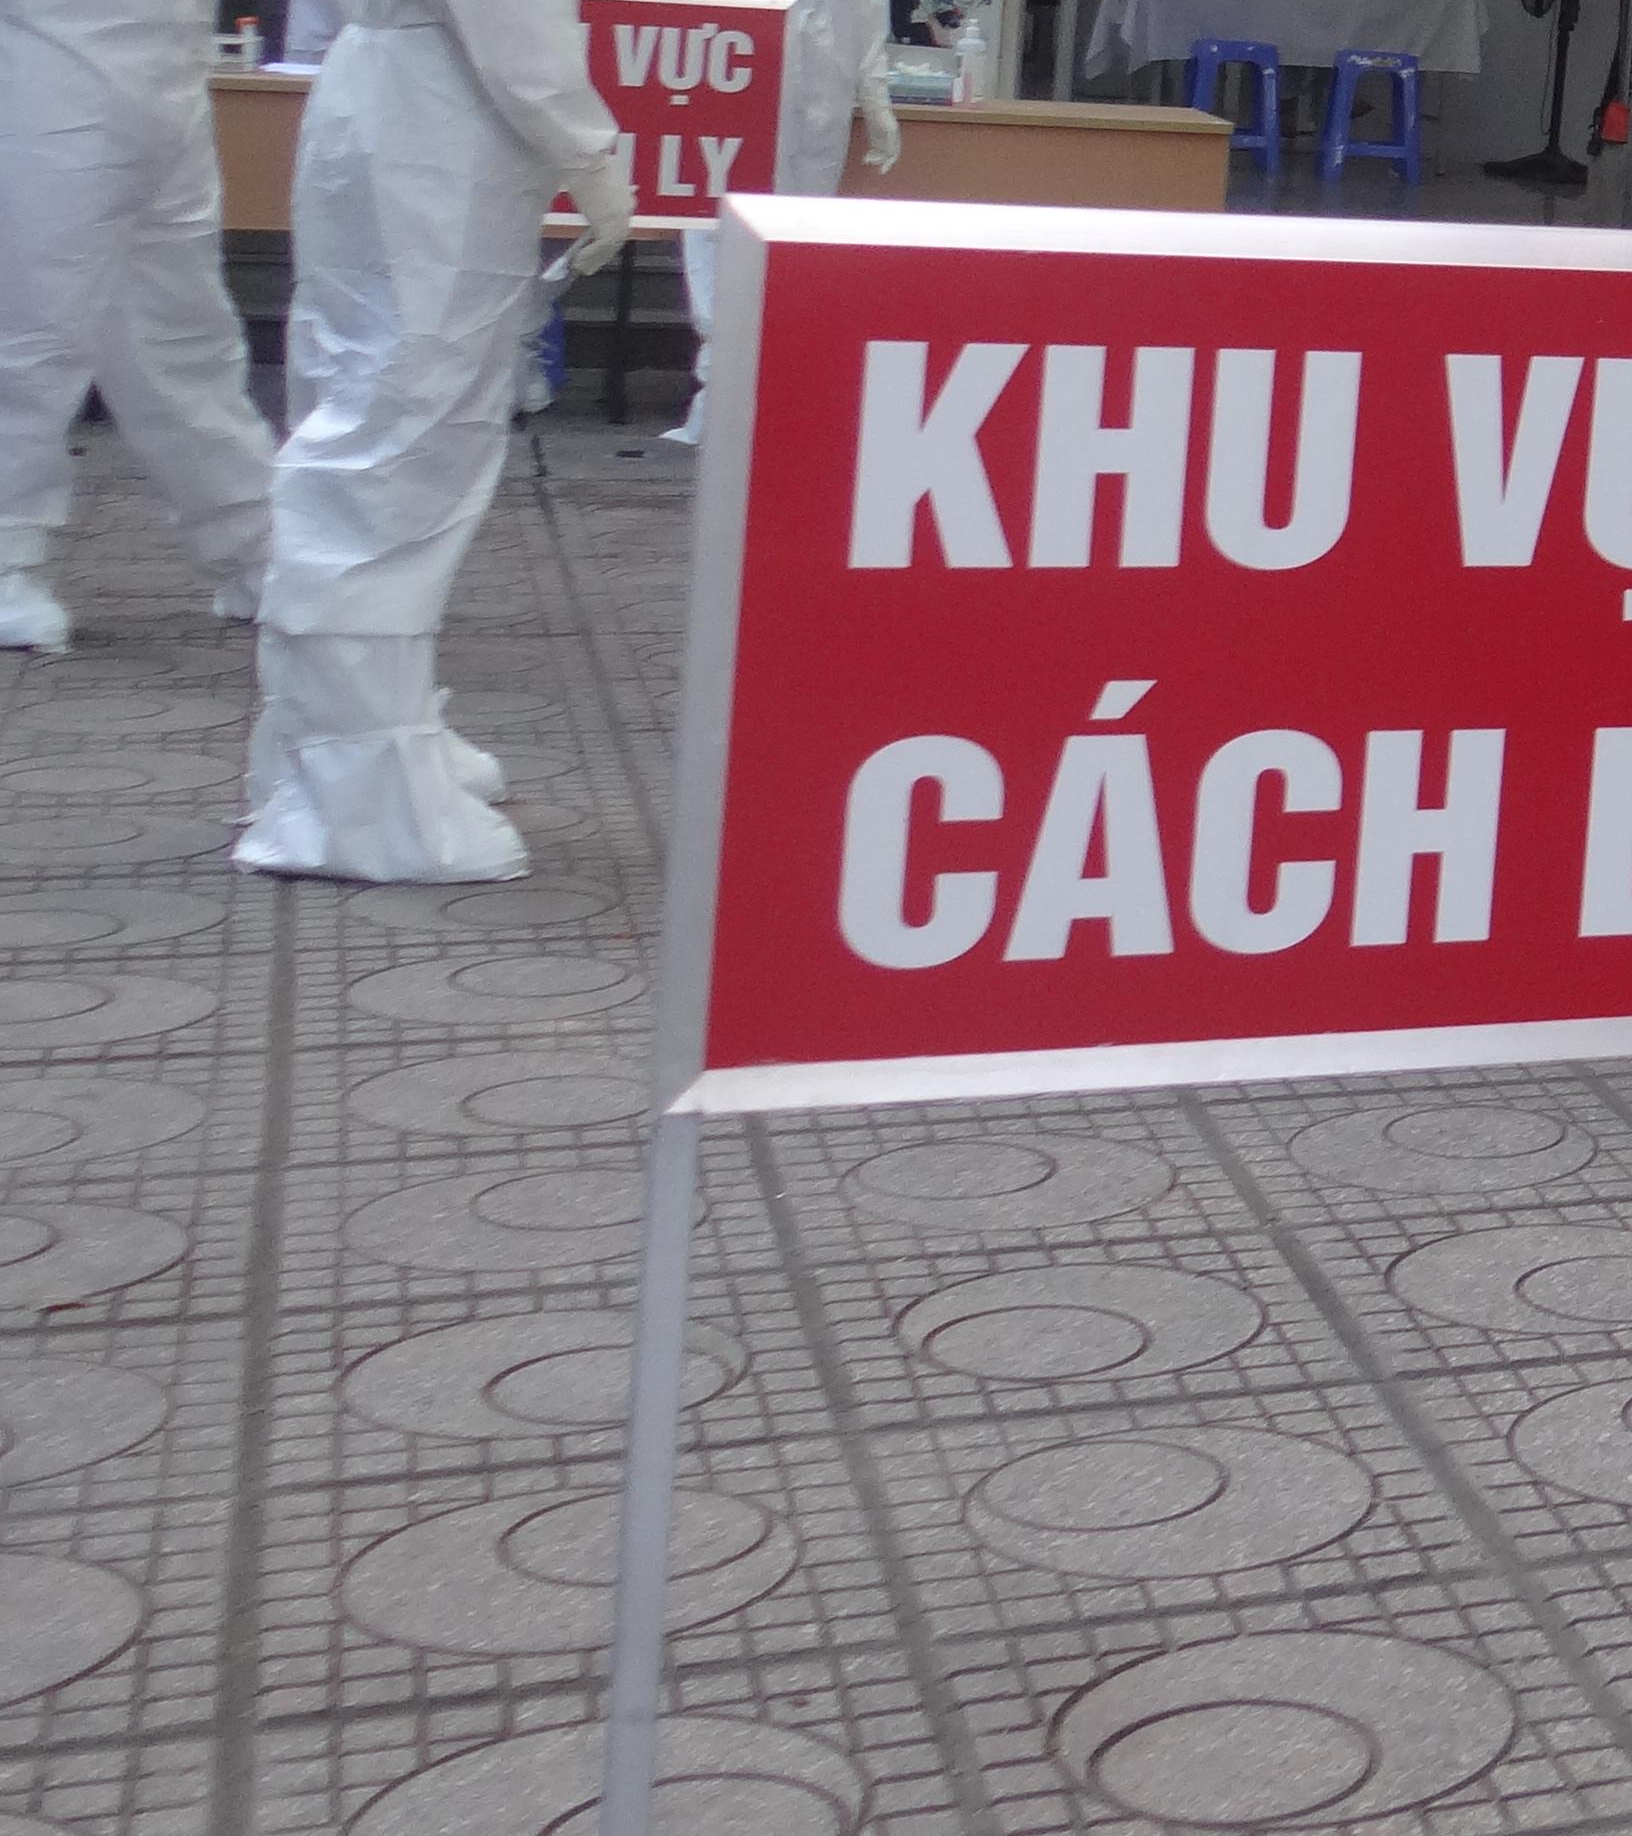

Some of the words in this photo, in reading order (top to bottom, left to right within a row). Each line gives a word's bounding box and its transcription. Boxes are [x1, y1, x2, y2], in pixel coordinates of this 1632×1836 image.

[613, 23, 755, 106] VỰC
[657, 135, 744, 198] LY
[847, 339, 1363, 570] KHU
[837, 680, 1506, 970] CÁCH
